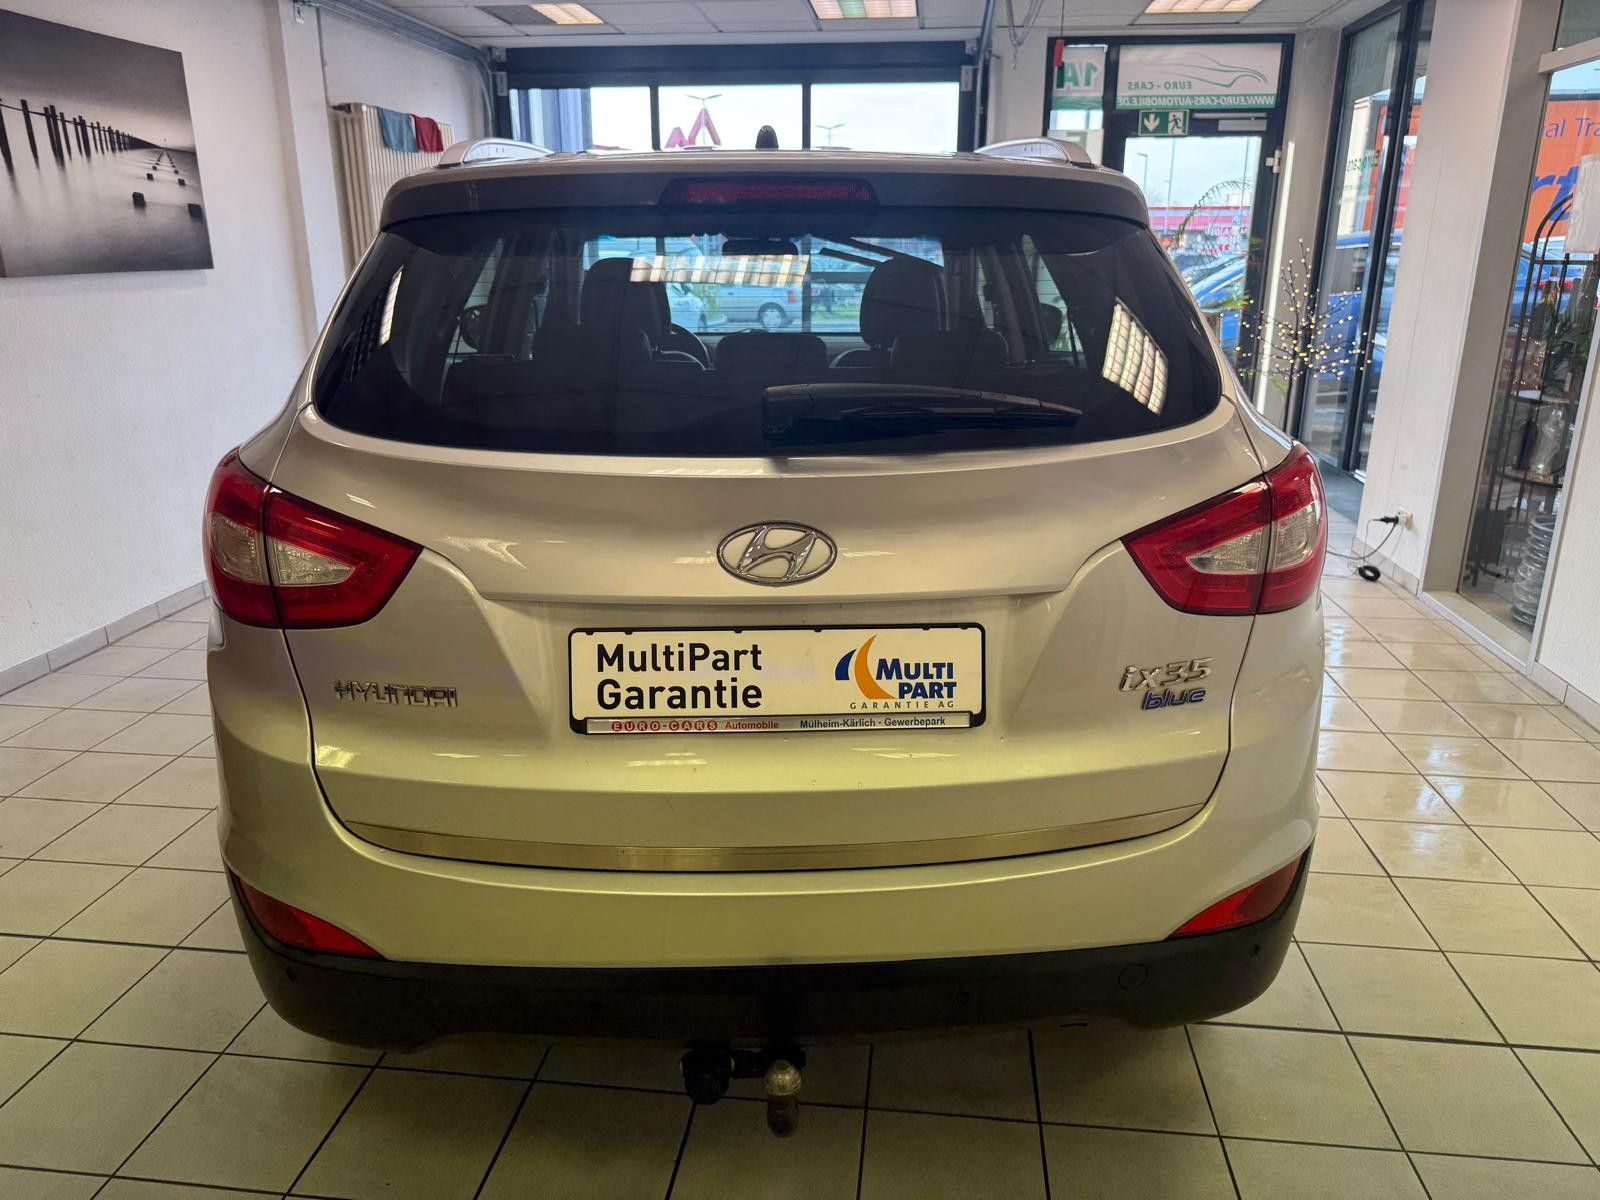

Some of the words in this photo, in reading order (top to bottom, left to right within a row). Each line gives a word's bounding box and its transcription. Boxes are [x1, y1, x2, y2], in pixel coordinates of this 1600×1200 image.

[597, 643, 763, 672] MultiPart
[876, 658, 954, 680] MULTI
[1119, 657, 1213, 692] ix35
[334, 679, 459, 708] HYUNDAI
[597, 677, 763, 710] Garantie
[898, 682, 957, 699] PART
[1141, 687, 1207, 710] blue
[850, 702, 930, 710] GARANTIE
[938, 701, 954, 709] AG
[611, 720, 718, 731] EURO-CARS
[725, 720, 779, 730] Automobile
[799, 718, 876, 729] Mülheim-Kärlich
[884, 717, 945, 728] Gewerbepark
